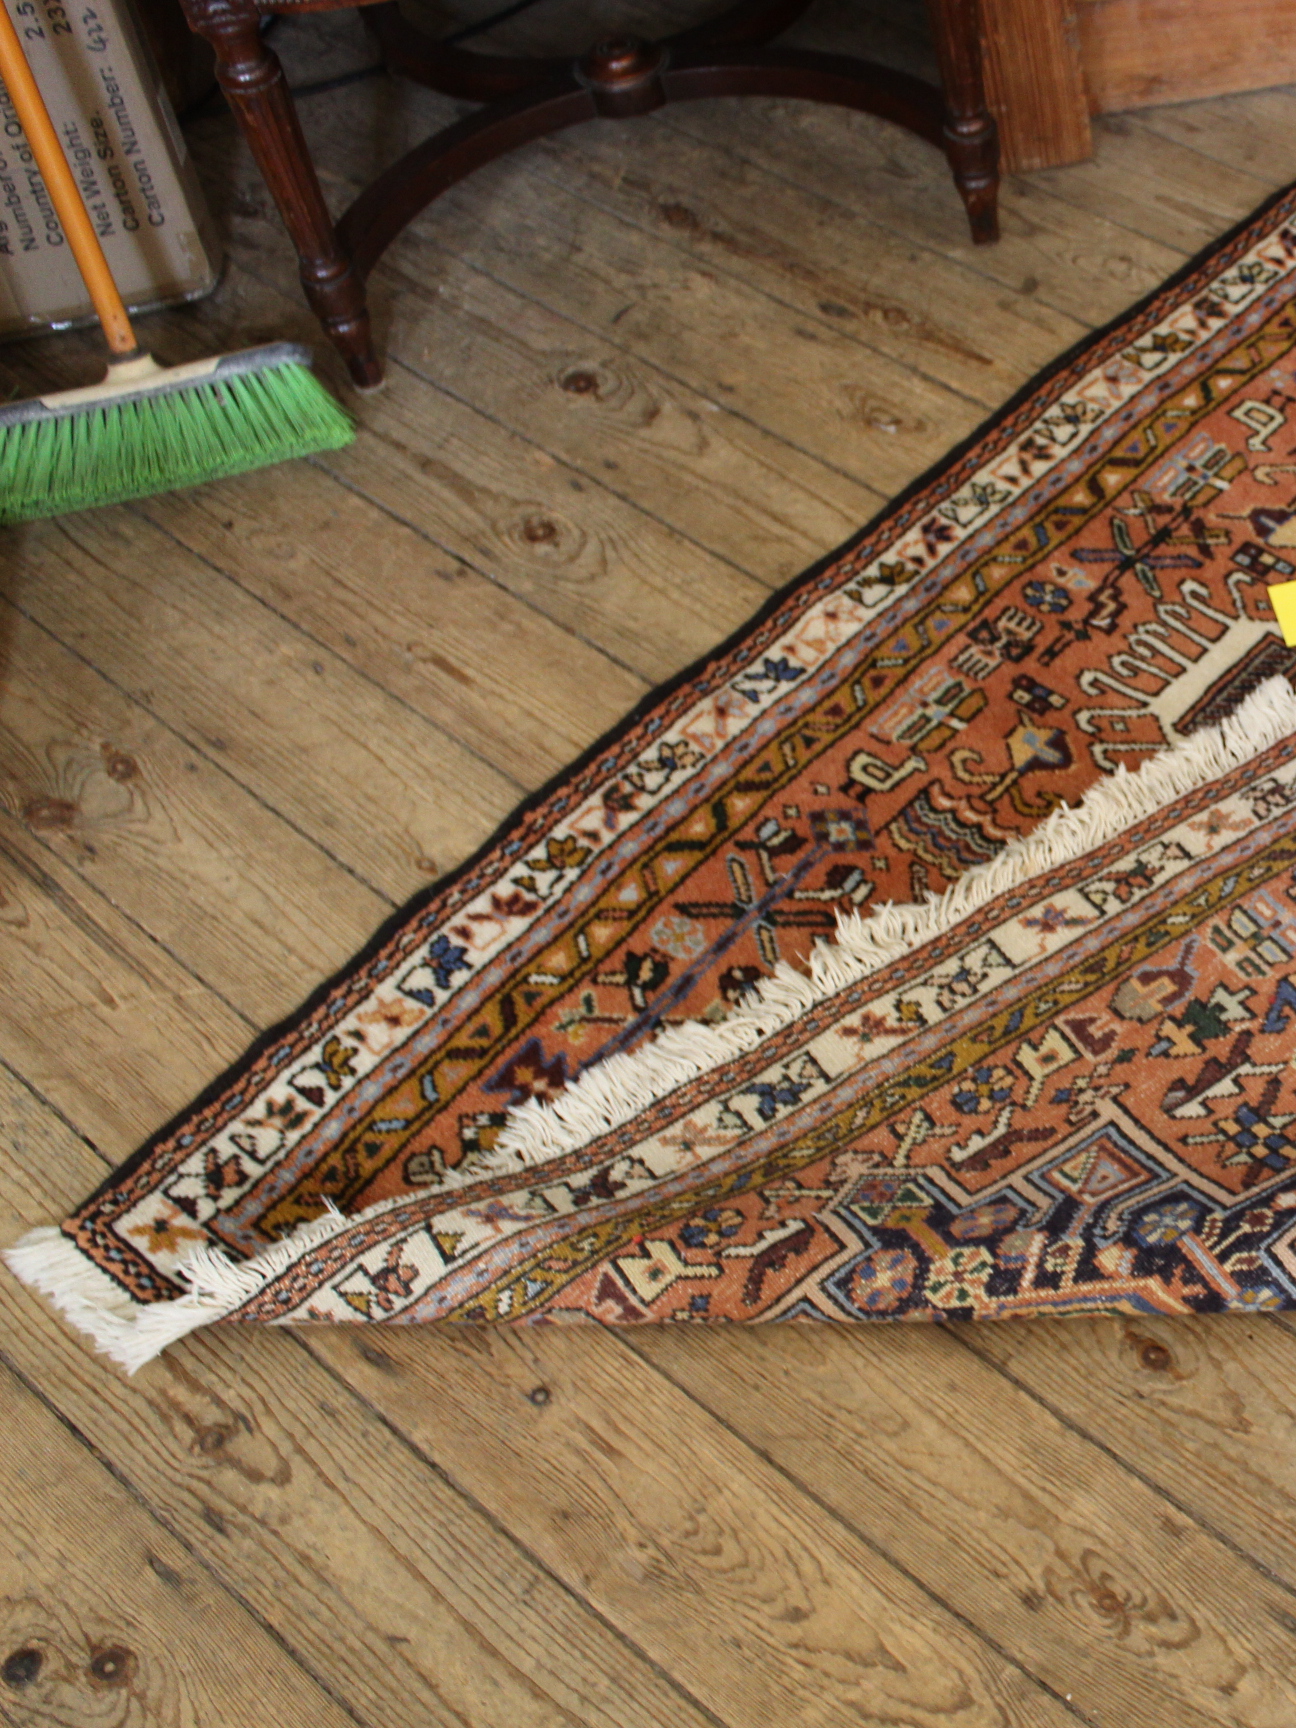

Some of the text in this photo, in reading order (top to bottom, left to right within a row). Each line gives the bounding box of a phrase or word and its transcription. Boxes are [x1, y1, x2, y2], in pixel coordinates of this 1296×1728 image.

[17, 1, 117, 237] Net Weight: 2.5
[99, 65, 142, 157] Number:
[0, 176, 39, 252] Number
[25, 168, 64, 247] Country
[107, 164, 140, 232] Carton
[133, 159, 166, 227] Carton
